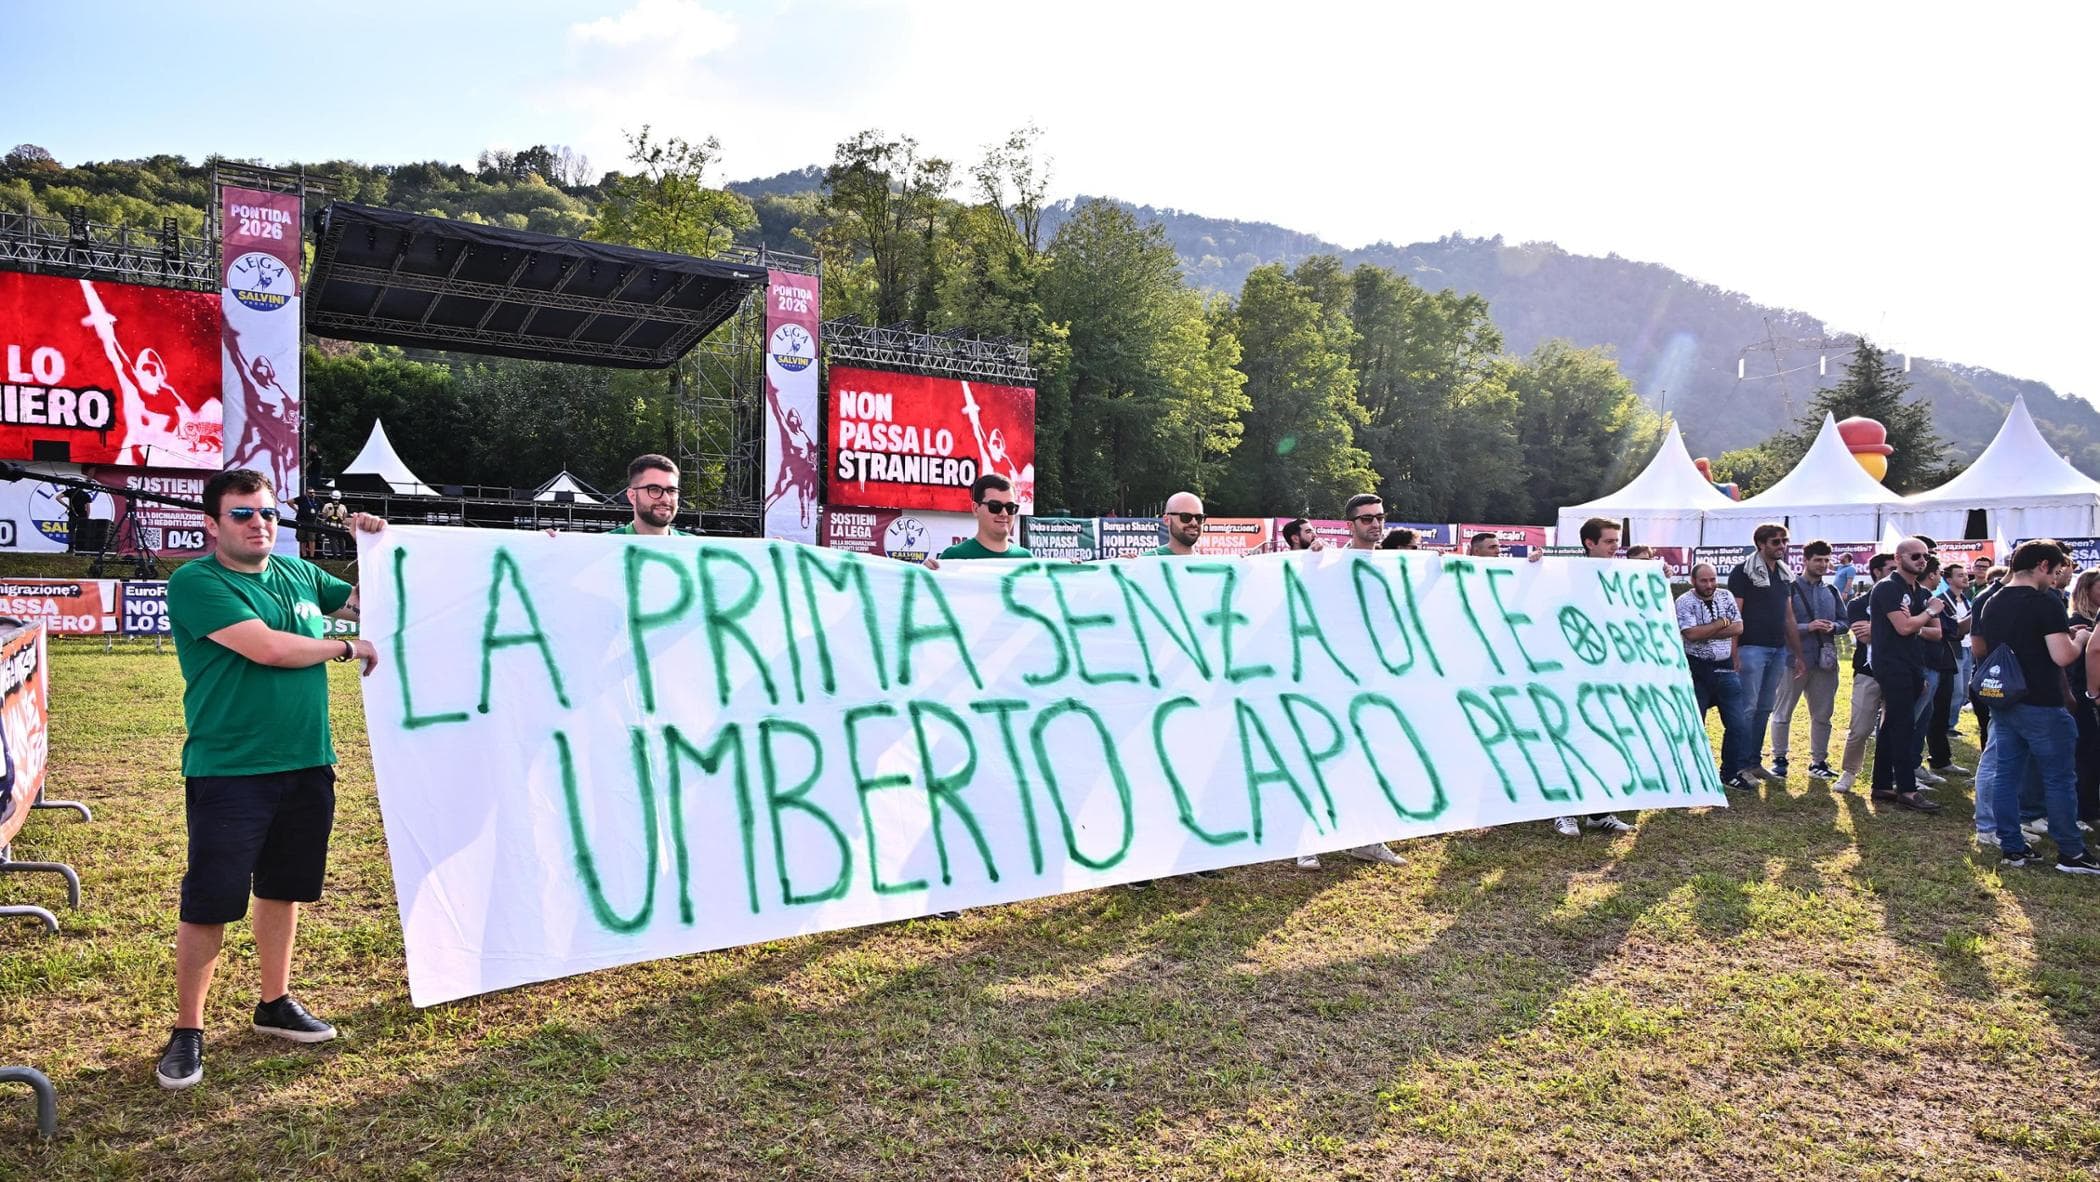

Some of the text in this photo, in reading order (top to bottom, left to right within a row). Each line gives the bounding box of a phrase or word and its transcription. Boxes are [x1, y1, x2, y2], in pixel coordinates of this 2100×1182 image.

[231, 204, 292, 225] PONTIDA
[239, 218, 283, 240] 2026
[235, 256, 285, 278] LEGA
[238, 290, 285, 305] SALVINI
[772, 285, 813, 301] PONTIDA
[778, 297, 808, 313] 2026
[776, 326, 808, 344] LEGA
[8, 344, 65, 386] LO
[777, 355, 809, 366] SALVINI
[0, 384, 110, 428] IERO
[839, 389, 893, 422] NON
[839, 419, 954, 456] PASSA LO
[839, 449, 976, 487] STRANIERO
[126, 476, 204, 494] SOSTIENI
[41, 521, 70, 533] SAL
[830, 513, 877, 526] SOSTIENI
[1103, 522, 1125, 533] Burqa
[1131, 522, 1160, 531] Sharia?
[830, 525, 872, 538] LA LEGA
[889, 519, 924, 537] LEGA
[168, 530, 204, 548] D43
[1030, 535, 1079, 548] NON PASSA
[1103, 535, 1160, 548] NON PASSA
[1042, 548, 1093, 560] STRANIERO
[1103, 547, 1117, 559] LO
[1937, 543, 1982, 552] igrazione?
[2072, 549, 2100, 560] SSA
[1942, 551, 1970, 561] SSA
[1597, 570, 1667, 612] MGP
[0, 598, 59, 615] ASSA
[126, 616, 154, 631] LO
[393, 545, 570, 729] LA
[625, 543, 983, 714] PRIMA
[1001, 560, 1361, 688] SENZA
[1442, 558, 1564, 675] TE
[554, 697, 1134, 933] UMBERTO
[1153, 691, 1449, 846] CAPO
[1456, 682, 1613, 803] PER
